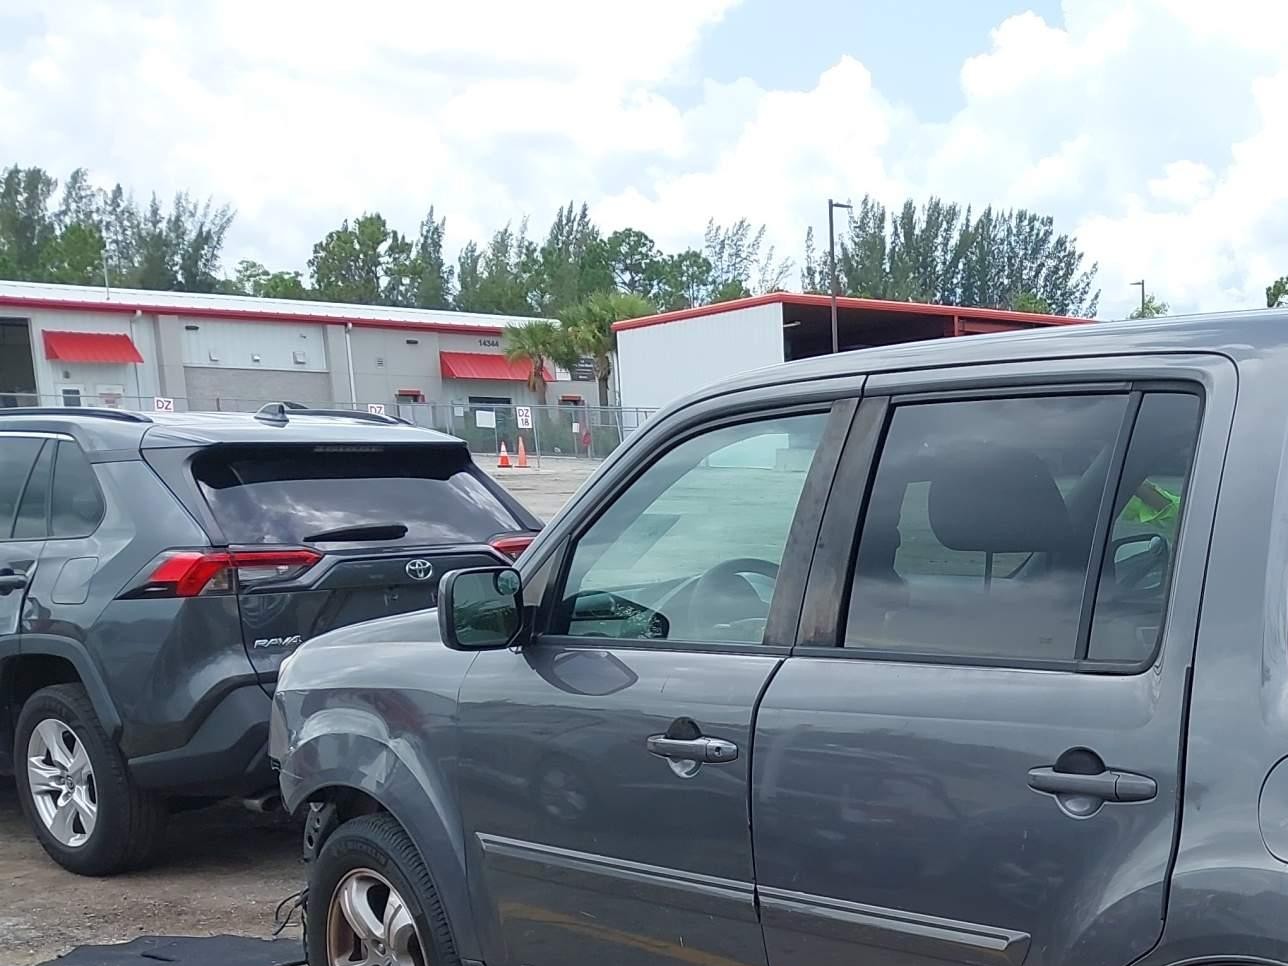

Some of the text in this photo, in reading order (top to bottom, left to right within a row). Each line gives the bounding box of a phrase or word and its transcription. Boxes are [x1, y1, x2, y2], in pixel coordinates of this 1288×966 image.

[156, 399, 172, 410] DZ
[517, 408, 530, 418] DZ
[520, 418, 530, 427] 18
[254, 635, 303, 649] RAV4
